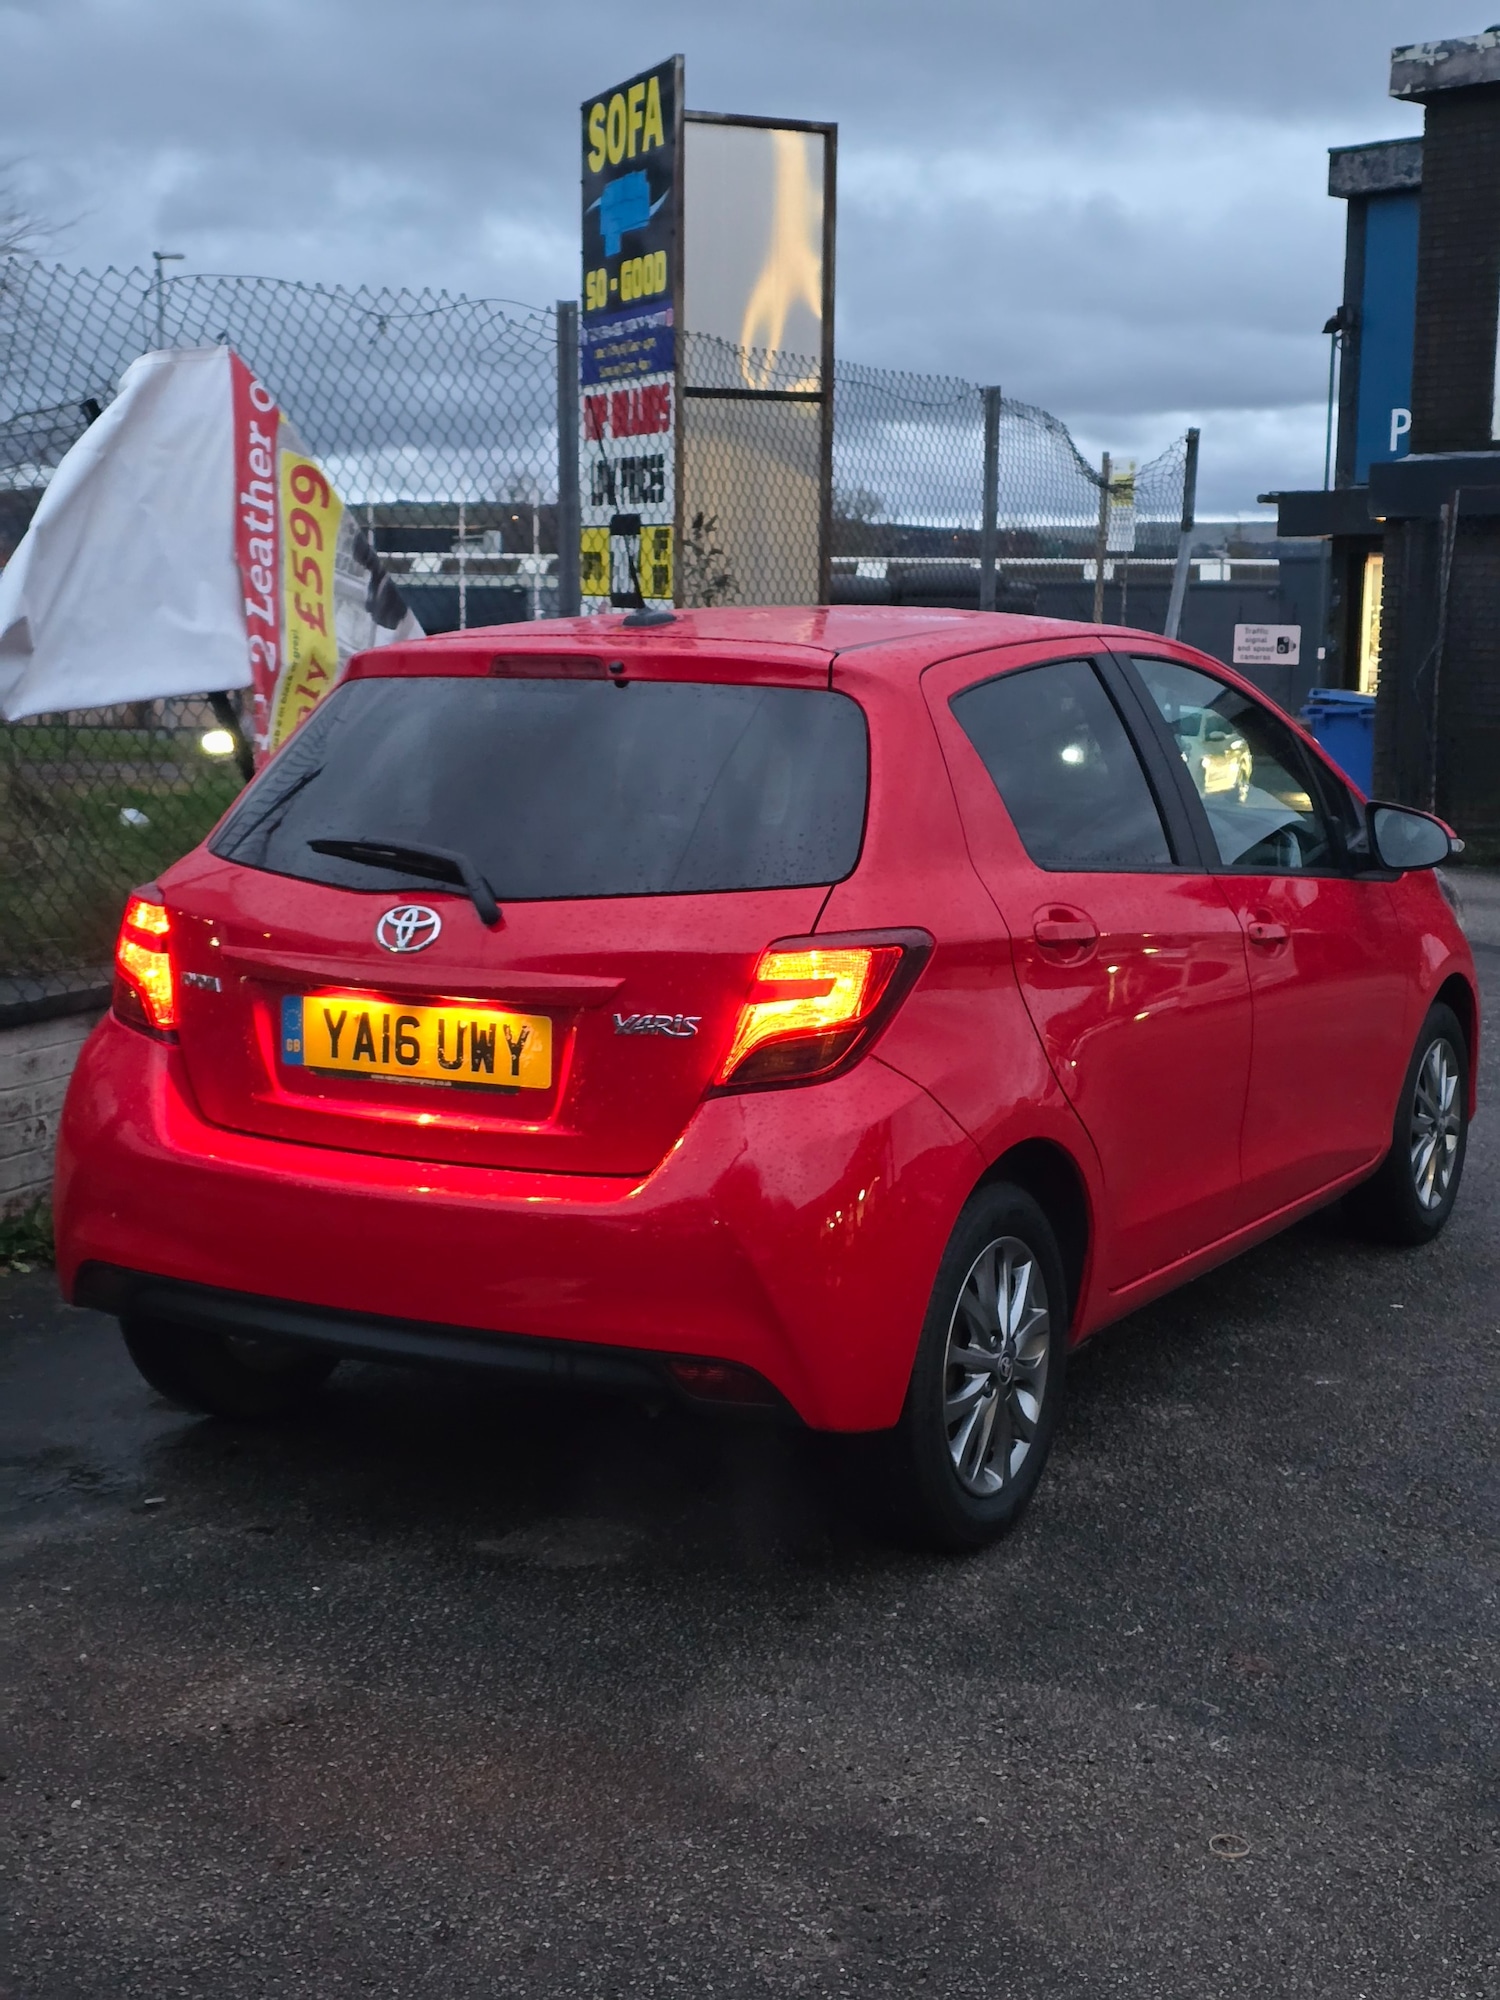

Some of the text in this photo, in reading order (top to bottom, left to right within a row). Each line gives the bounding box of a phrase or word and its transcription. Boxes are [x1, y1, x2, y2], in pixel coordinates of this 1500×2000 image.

[588, 76, 664, 173] SOFA
[1390, 407, 1412, 452] P
[241, 420, 275, 627] Leather
[289, 464, 330, 727] nly £599
[1245, 627, 1269, 635] Traffic
[1245, 636, 1268, 645] signal
[1253, 645, 1275, 653] speed
[248, 634, 276, 673] 2
[286, 1038, 301, 1053] GB
[323, 1008, 531, 1077] YA16 UWY
